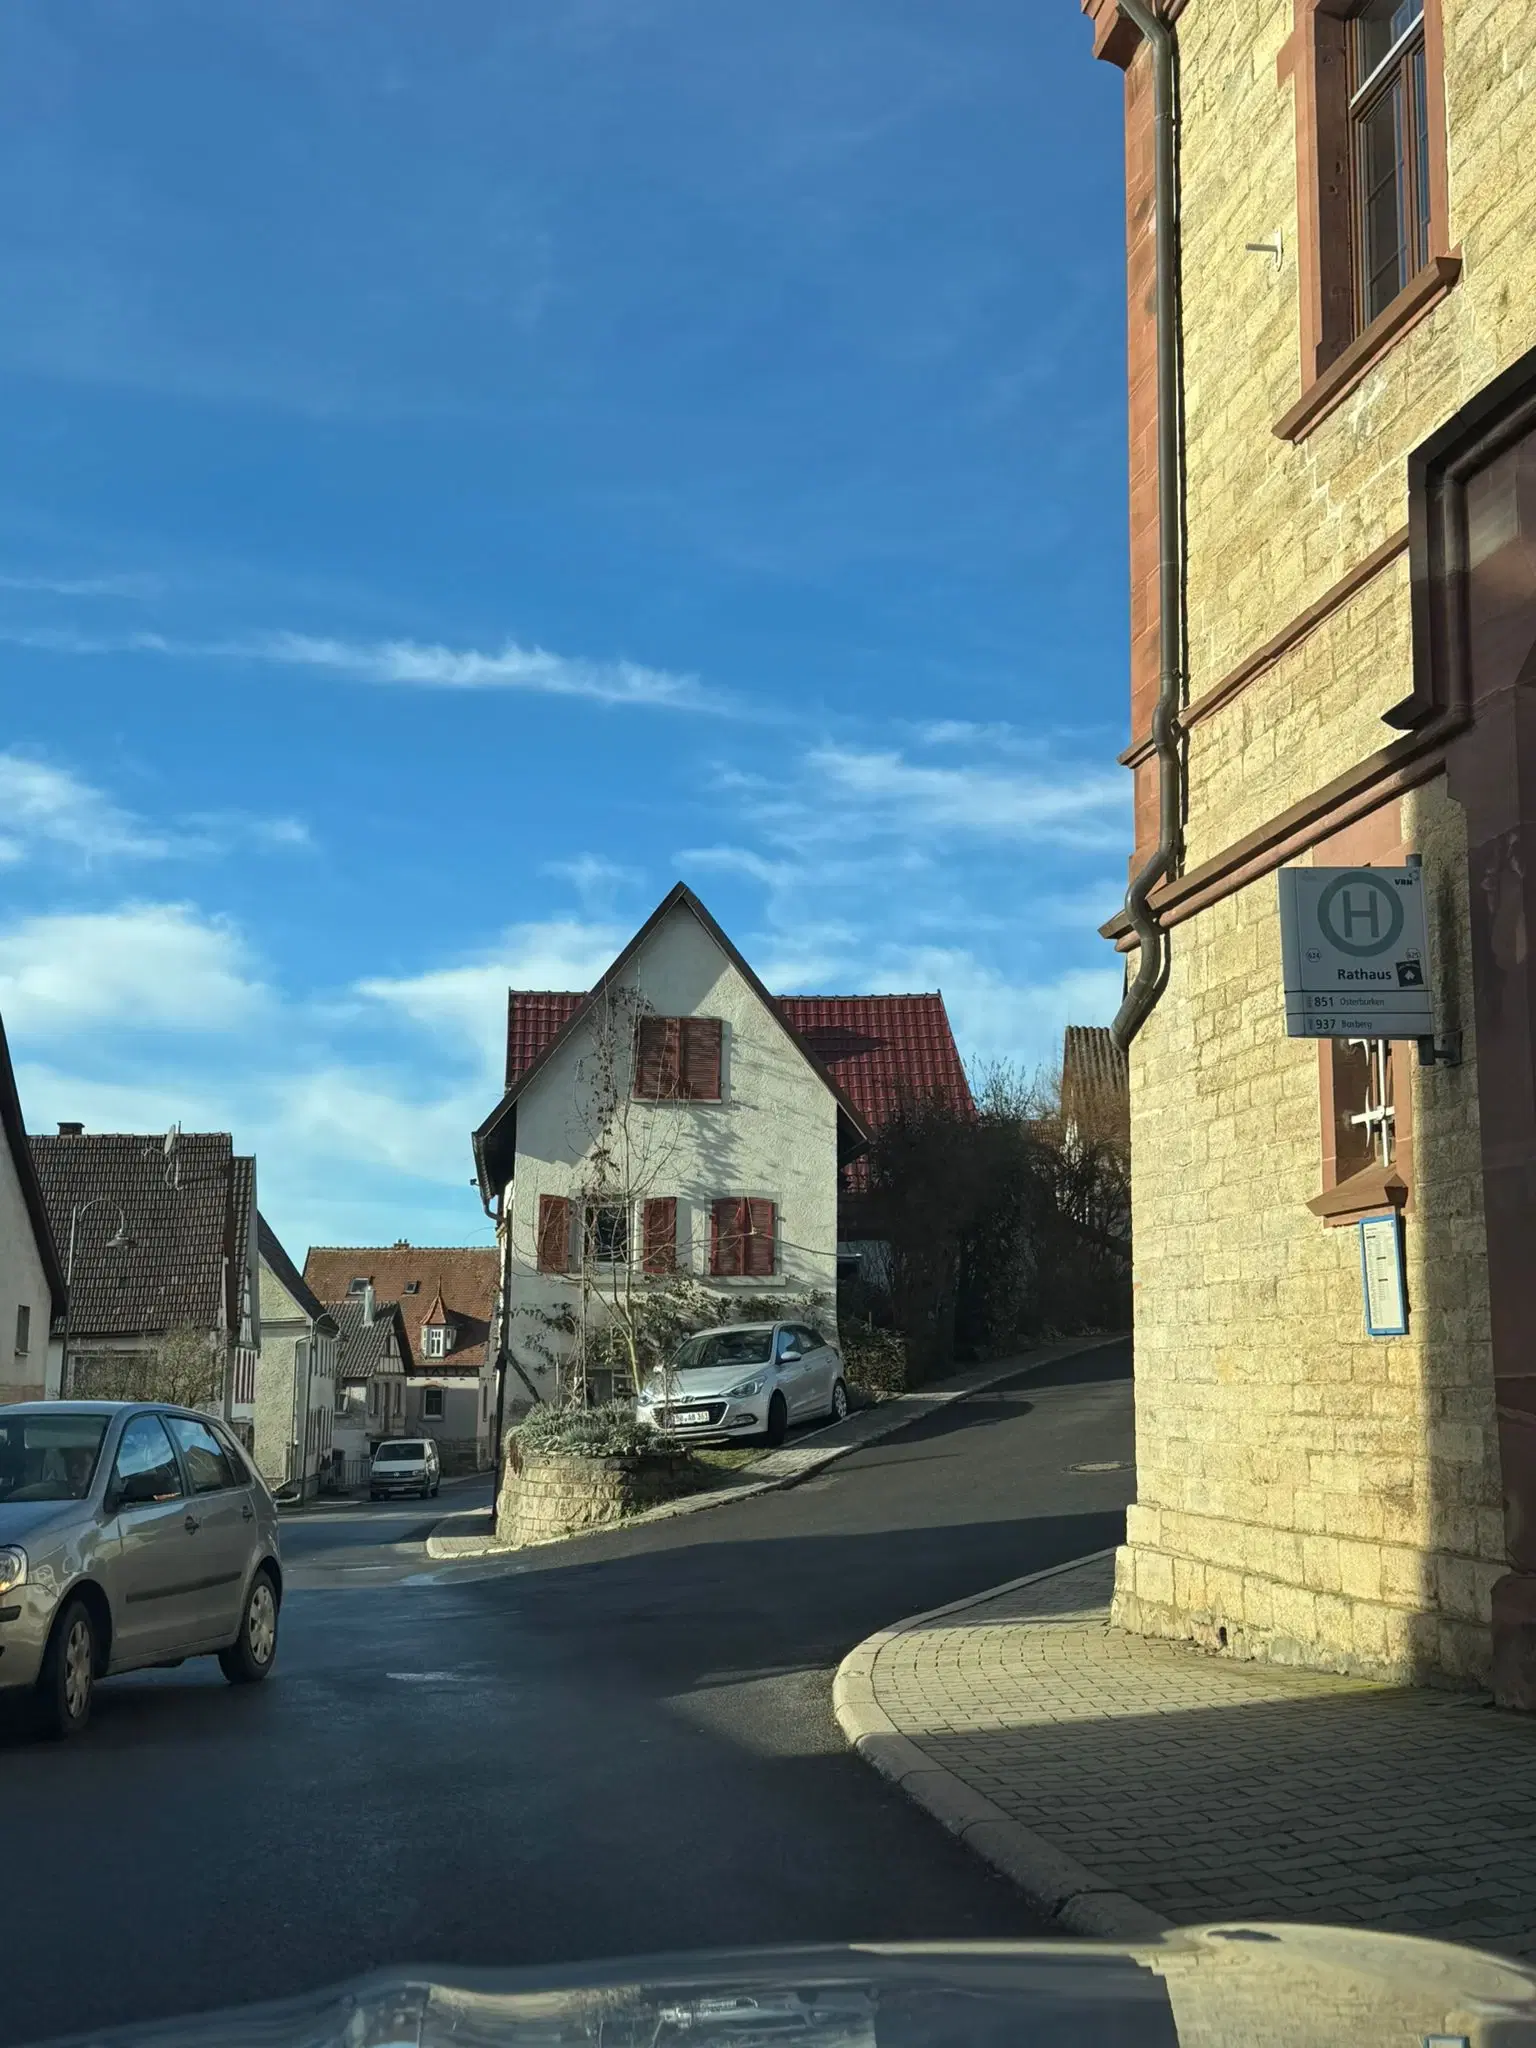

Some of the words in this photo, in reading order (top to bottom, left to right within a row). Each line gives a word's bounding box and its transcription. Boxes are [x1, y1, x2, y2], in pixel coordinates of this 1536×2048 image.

[1342, 889, 1380, 938] H
[1337, 968, 1392, 981] Rathaus
[1314, 996, 1334, 1008] 851
[1339, 997, 1385, 1007] Osterburken
[1315, 1019, 1336, 1030] 937
